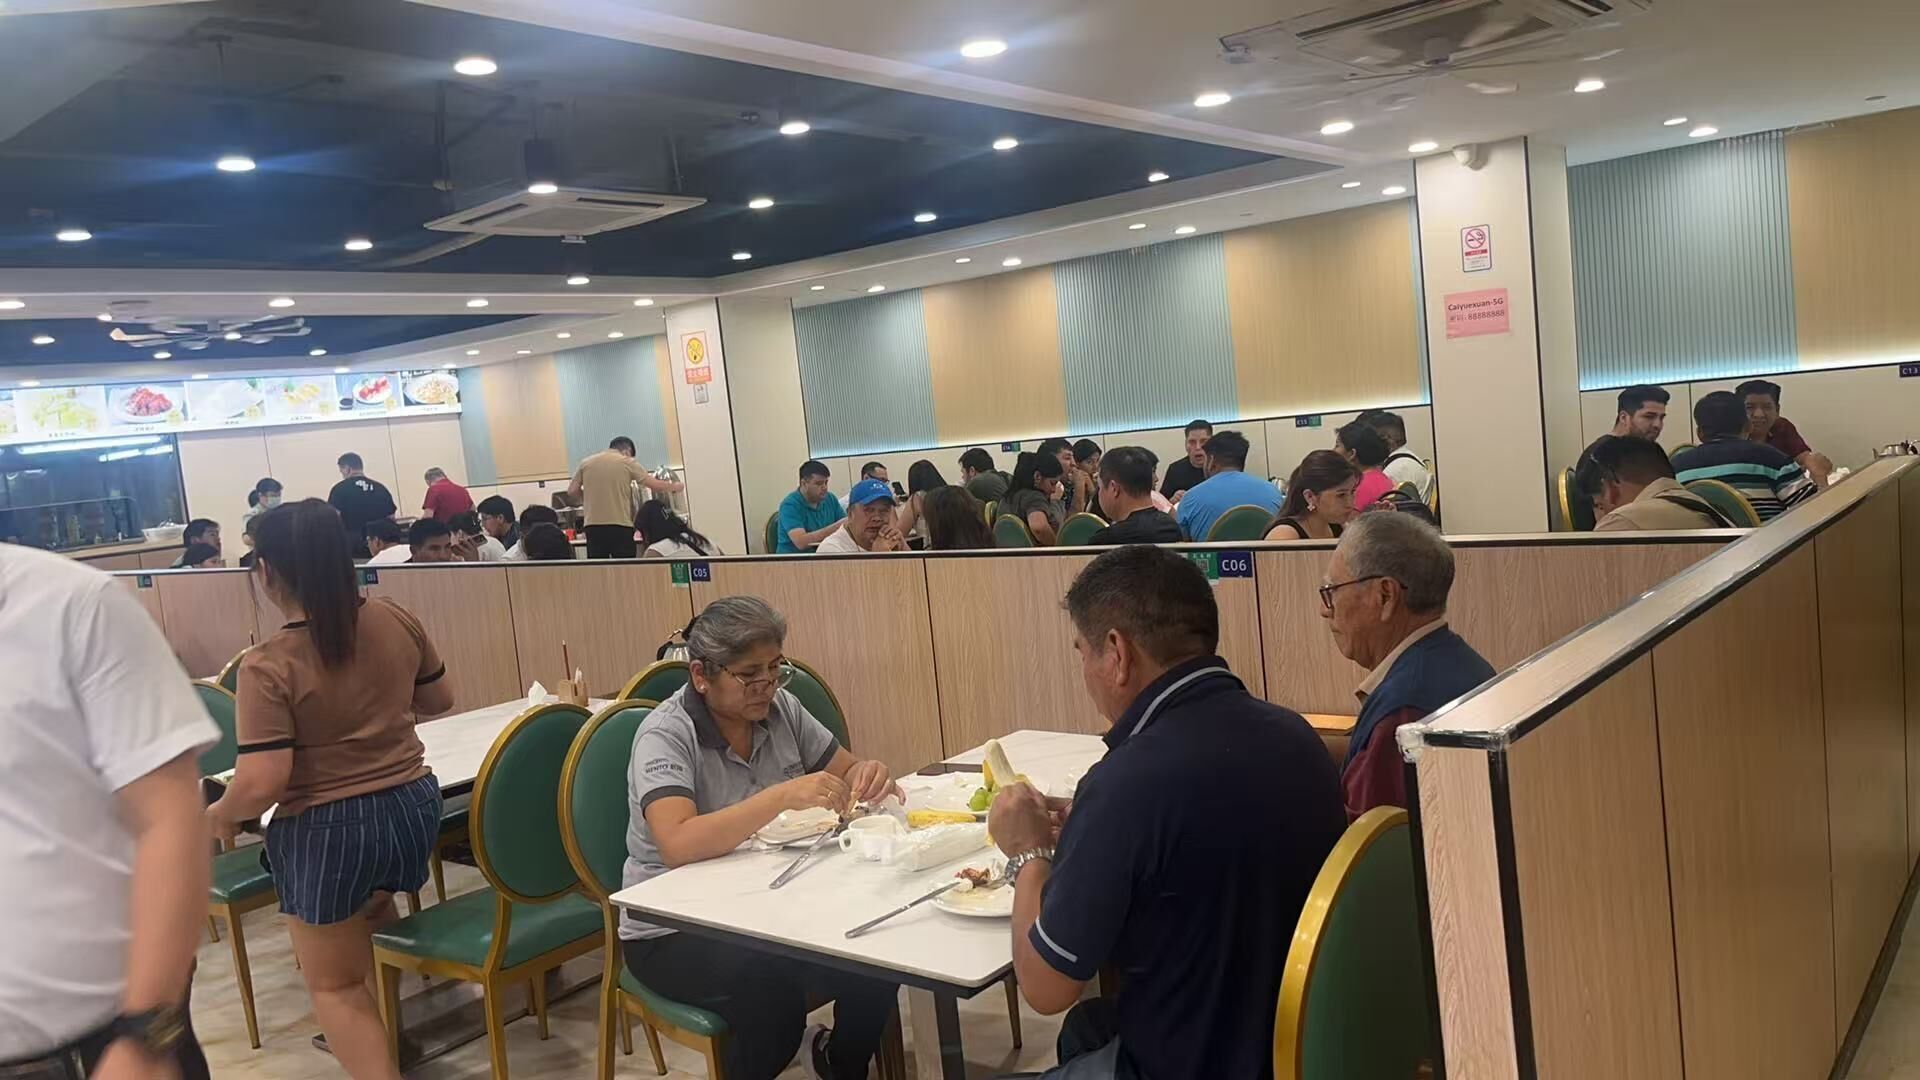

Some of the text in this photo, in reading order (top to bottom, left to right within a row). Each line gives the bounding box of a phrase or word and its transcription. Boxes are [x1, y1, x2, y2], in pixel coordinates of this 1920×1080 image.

[1447, 297, 1504, 311] Caiyuexuan-5G
[1221, 559, 1247, 571] C06
[693, 568, 708, 577] C05
